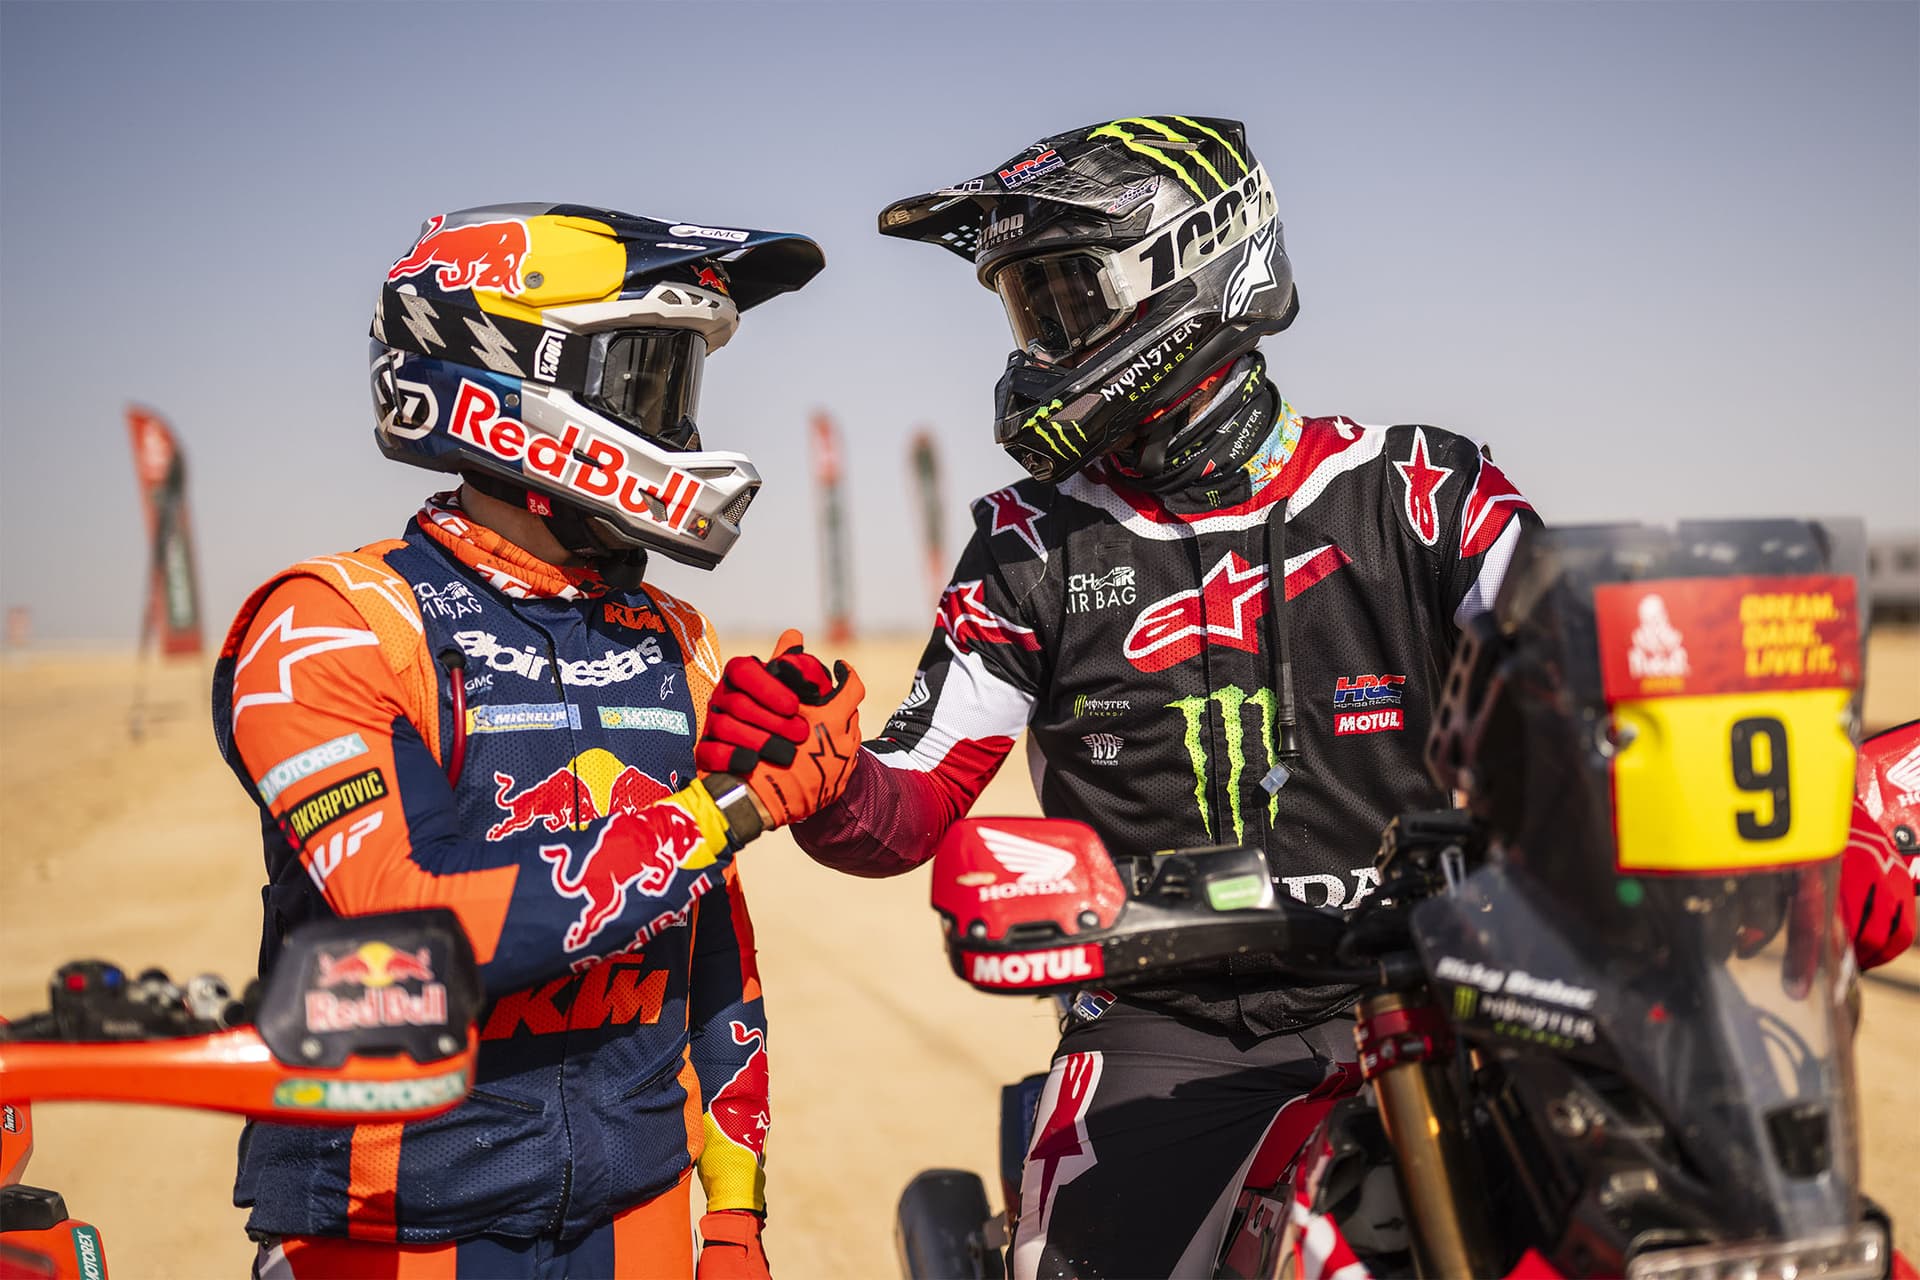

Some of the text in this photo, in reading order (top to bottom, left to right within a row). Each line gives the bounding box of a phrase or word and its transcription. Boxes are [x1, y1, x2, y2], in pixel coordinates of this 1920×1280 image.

[701, 230, 744, 240] GMC
[1140, 169, 1272, 291] 100%
[541, 336, 562, 377] 100%
[1100, 318, 1202, 401] MONSTER
[1129, 343, 1195, 401] ENERGY
[451, 382, 700, 531] Red Bull
[603, 602, 666, 633] KTM
[464, 674, 494, 690] GMC
[1334, 674, 1406, 703] HRC
[494, 712, 567, 723] MICHELIN
[1085, 699, 1130, 710] MONSTER
[1338, 712, 1400, 732] MOTUL
[262, 736, 362, 800] MOTOREX
[1732, 717, 1791, 841] 9
[979, 879, 1078, 902] HONDA
[973, 947, 1092, 983] MOTUL
[305, 982, 447, 1034] Red Bull
[480, 953, 669, 1041] KTM
